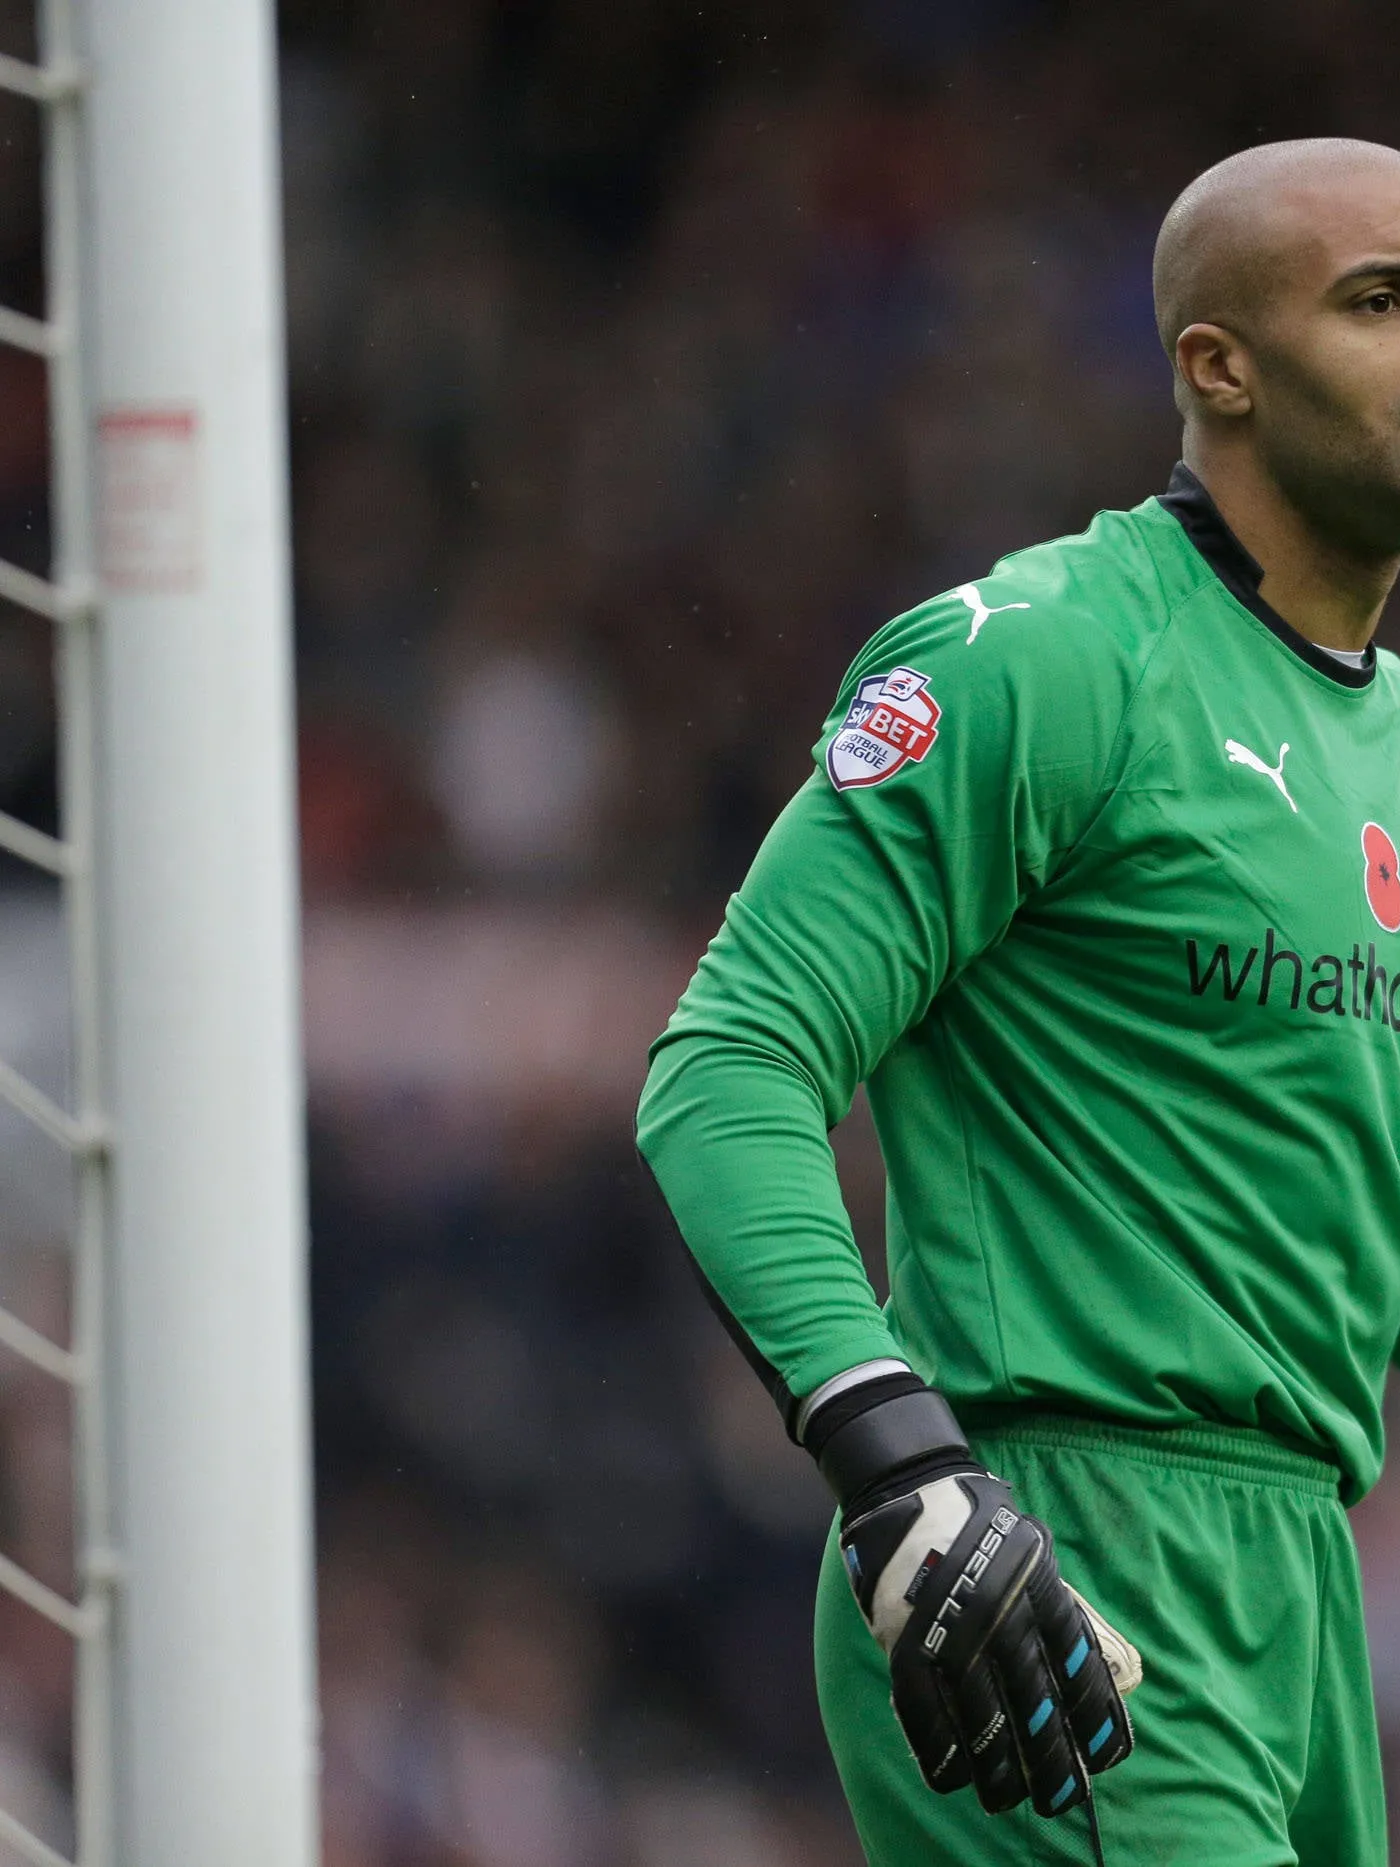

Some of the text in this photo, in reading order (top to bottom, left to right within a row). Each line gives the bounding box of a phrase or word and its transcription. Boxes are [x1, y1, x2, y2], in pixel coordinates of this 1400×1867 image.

[846, 733, 888, 760] OTBALL
[868, 707, 928, 750] BET
[835, 740, 886, 770] LEAGUE
[924, 1528, 1003, 1654] SELLS
